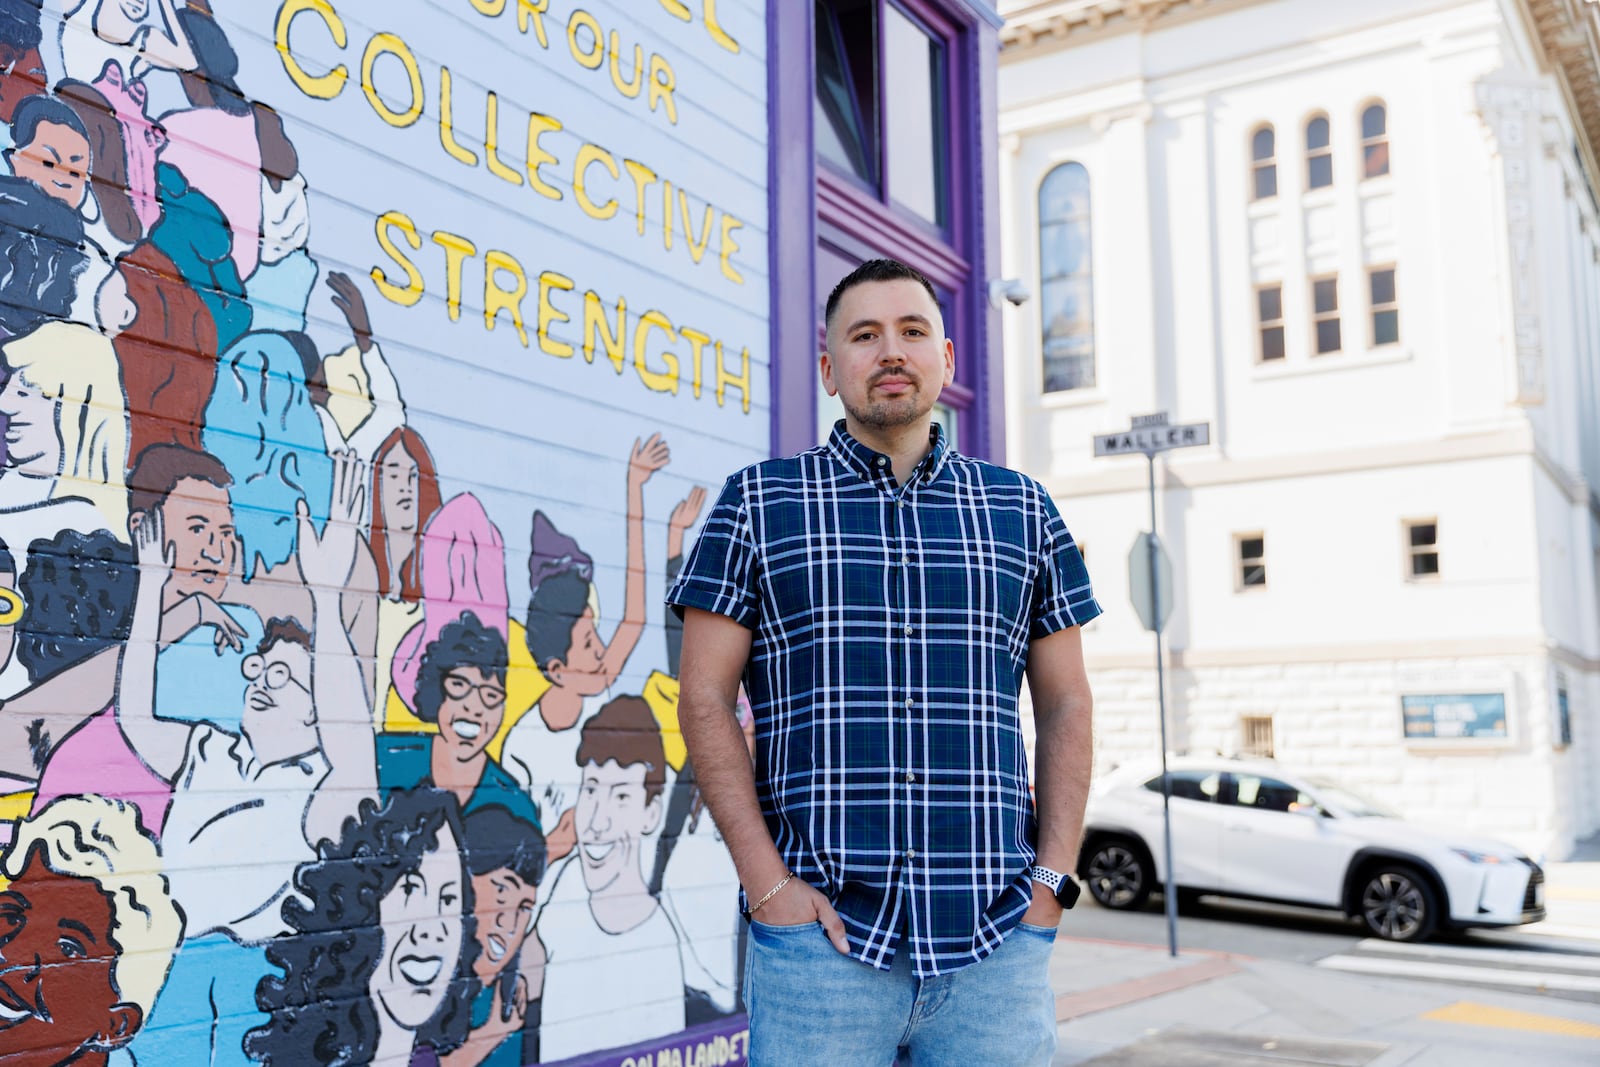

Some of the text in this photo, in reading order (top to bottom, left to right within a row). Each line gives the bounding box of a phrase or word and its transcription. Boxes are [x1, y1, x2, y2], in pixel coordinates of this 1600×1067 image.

[274, 0, 745, 286] COLLECTIVE
[566, 9, 678, 125] OUR
[370, 210, 752, 415] STRENGTH
